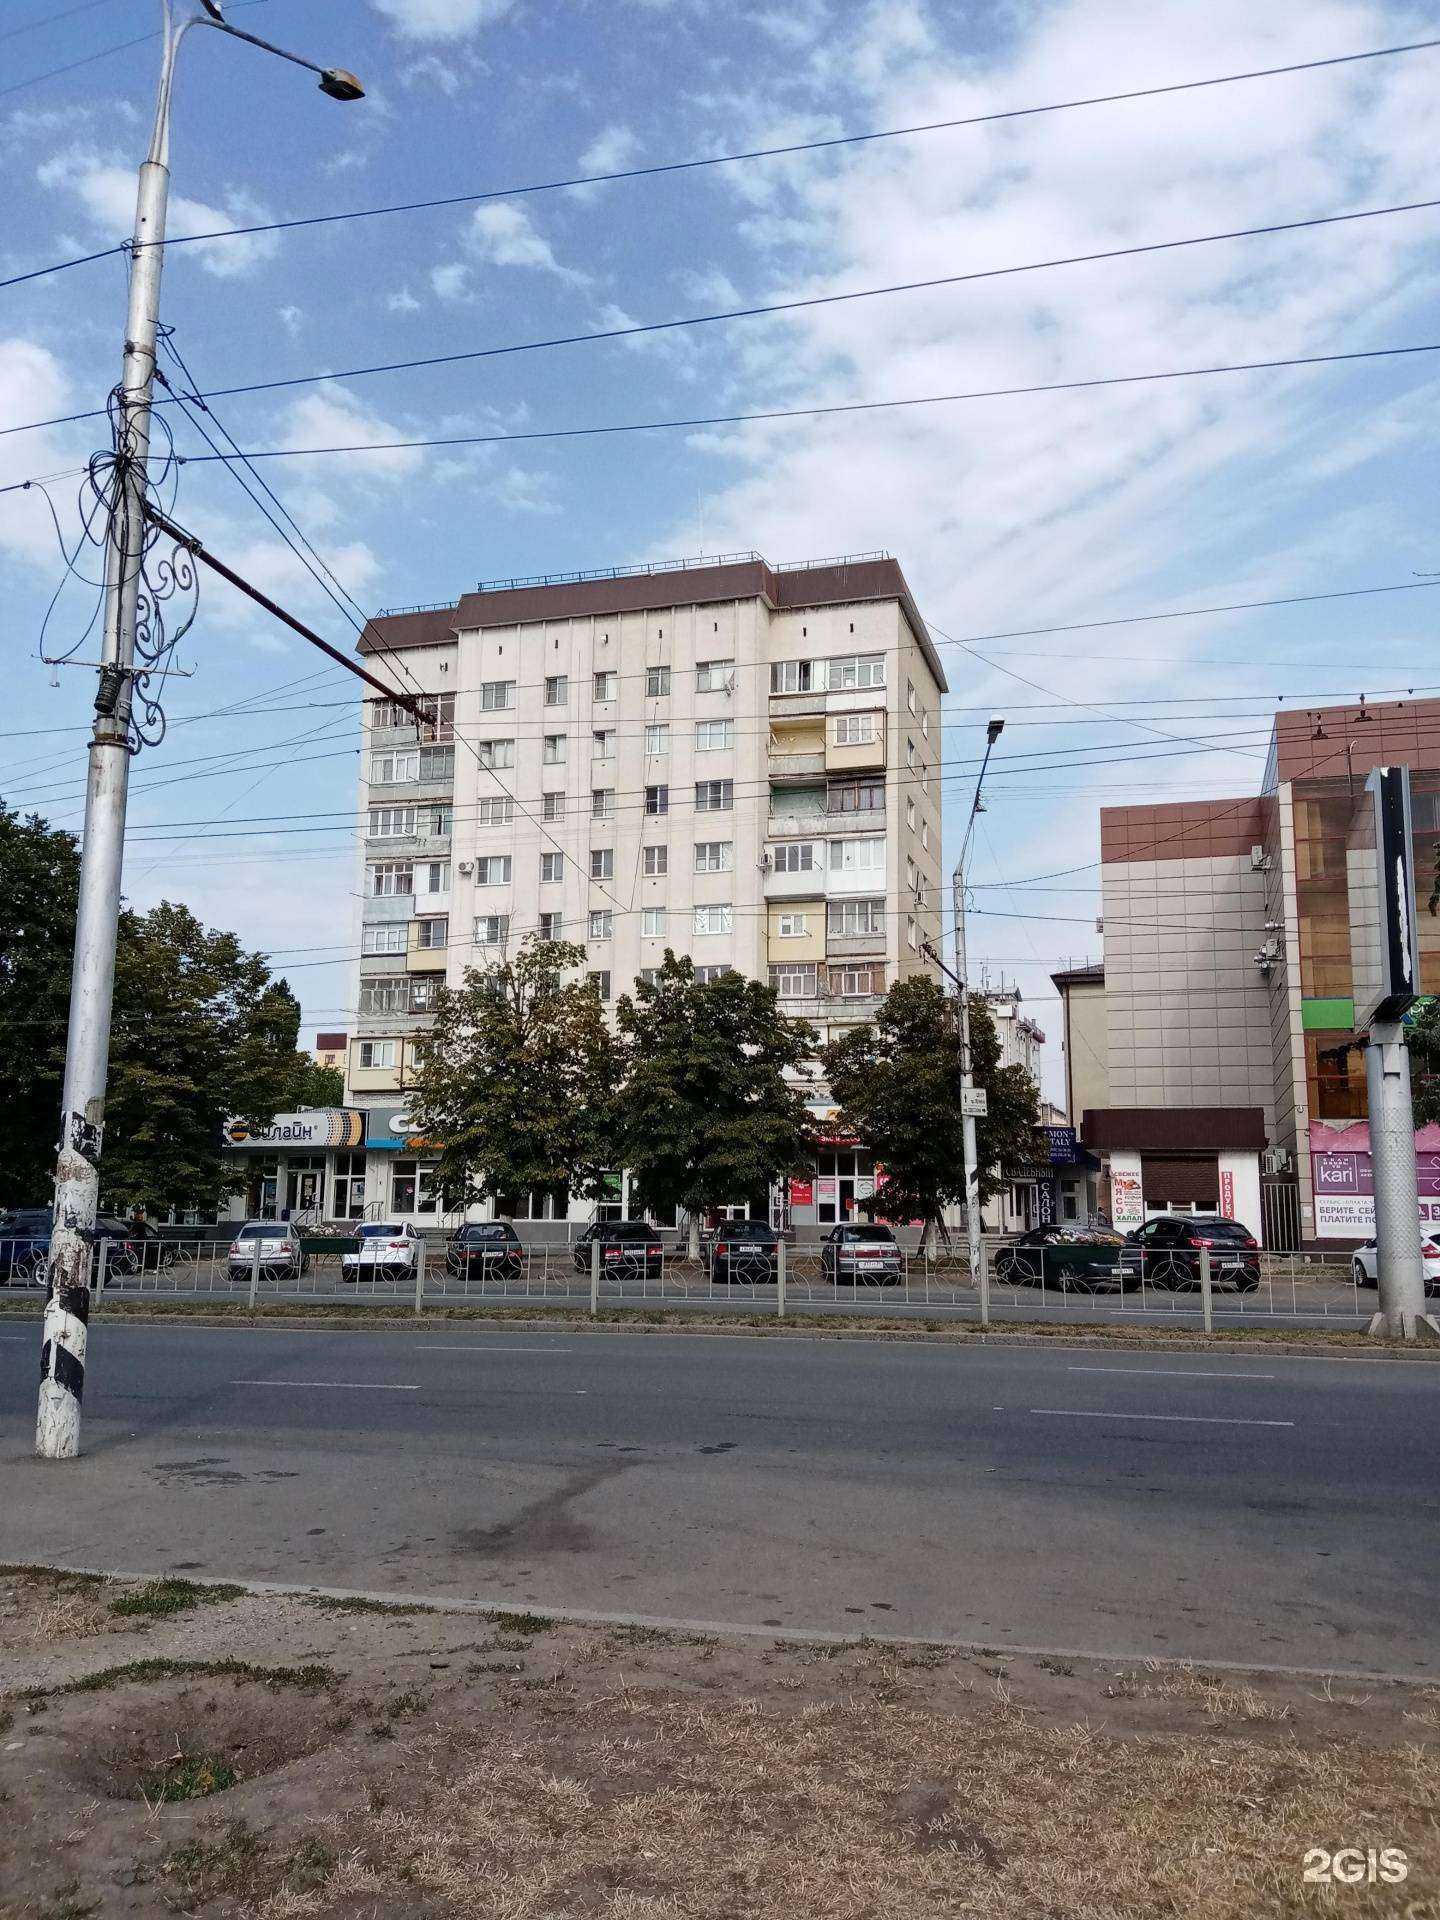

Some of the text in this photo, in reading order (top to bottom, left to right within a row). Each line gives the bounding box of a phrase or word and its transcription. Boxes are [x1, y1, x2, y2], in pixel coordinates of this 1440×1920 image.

[1320, 1165, 1353, 1183] kari
[1041, 1182, 1051, 1223] САЛОН
[1115, 1180, 1123, 1215] МЯСО
[1224, 1172, 1232, 1219] ПРОДУКТ
[1319, 1206, 1376, 1215] БЕРИТЕ СЕЙ
